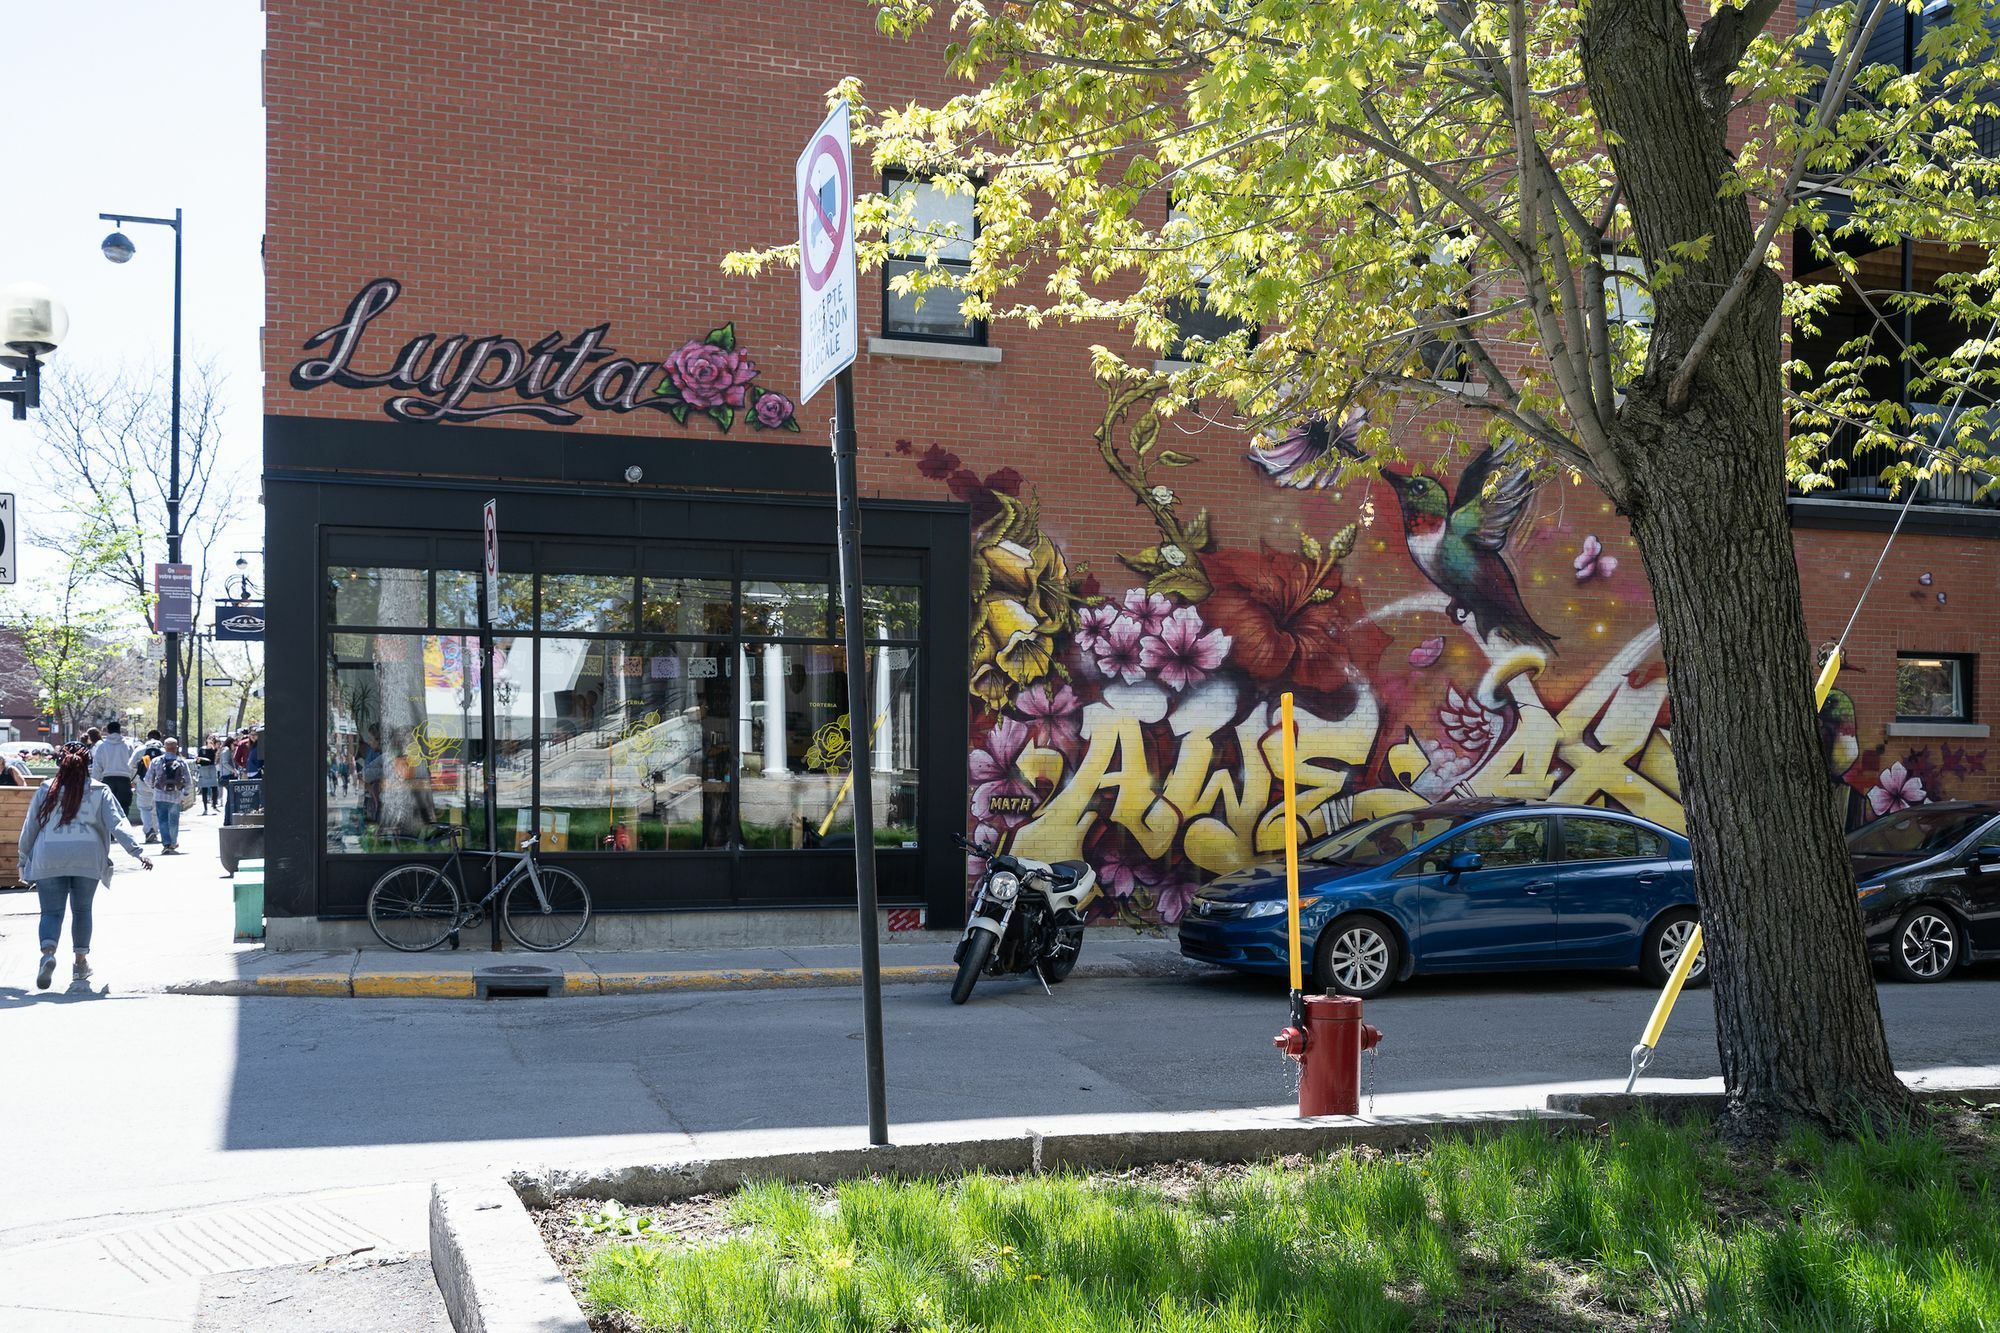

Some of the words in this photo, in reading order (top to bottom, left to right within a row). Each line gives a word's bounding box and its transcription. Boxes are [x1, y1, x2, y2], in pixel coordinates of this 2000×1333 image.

[807, 303, 848, 357] LIVRAISON
[810, 279, 843, 332] EXCEPTÉ
[290, 277, 672, 424] Lupita
[812, 333, 840, 374] LOCALE
[990, 797, 1031, 811] MATH
